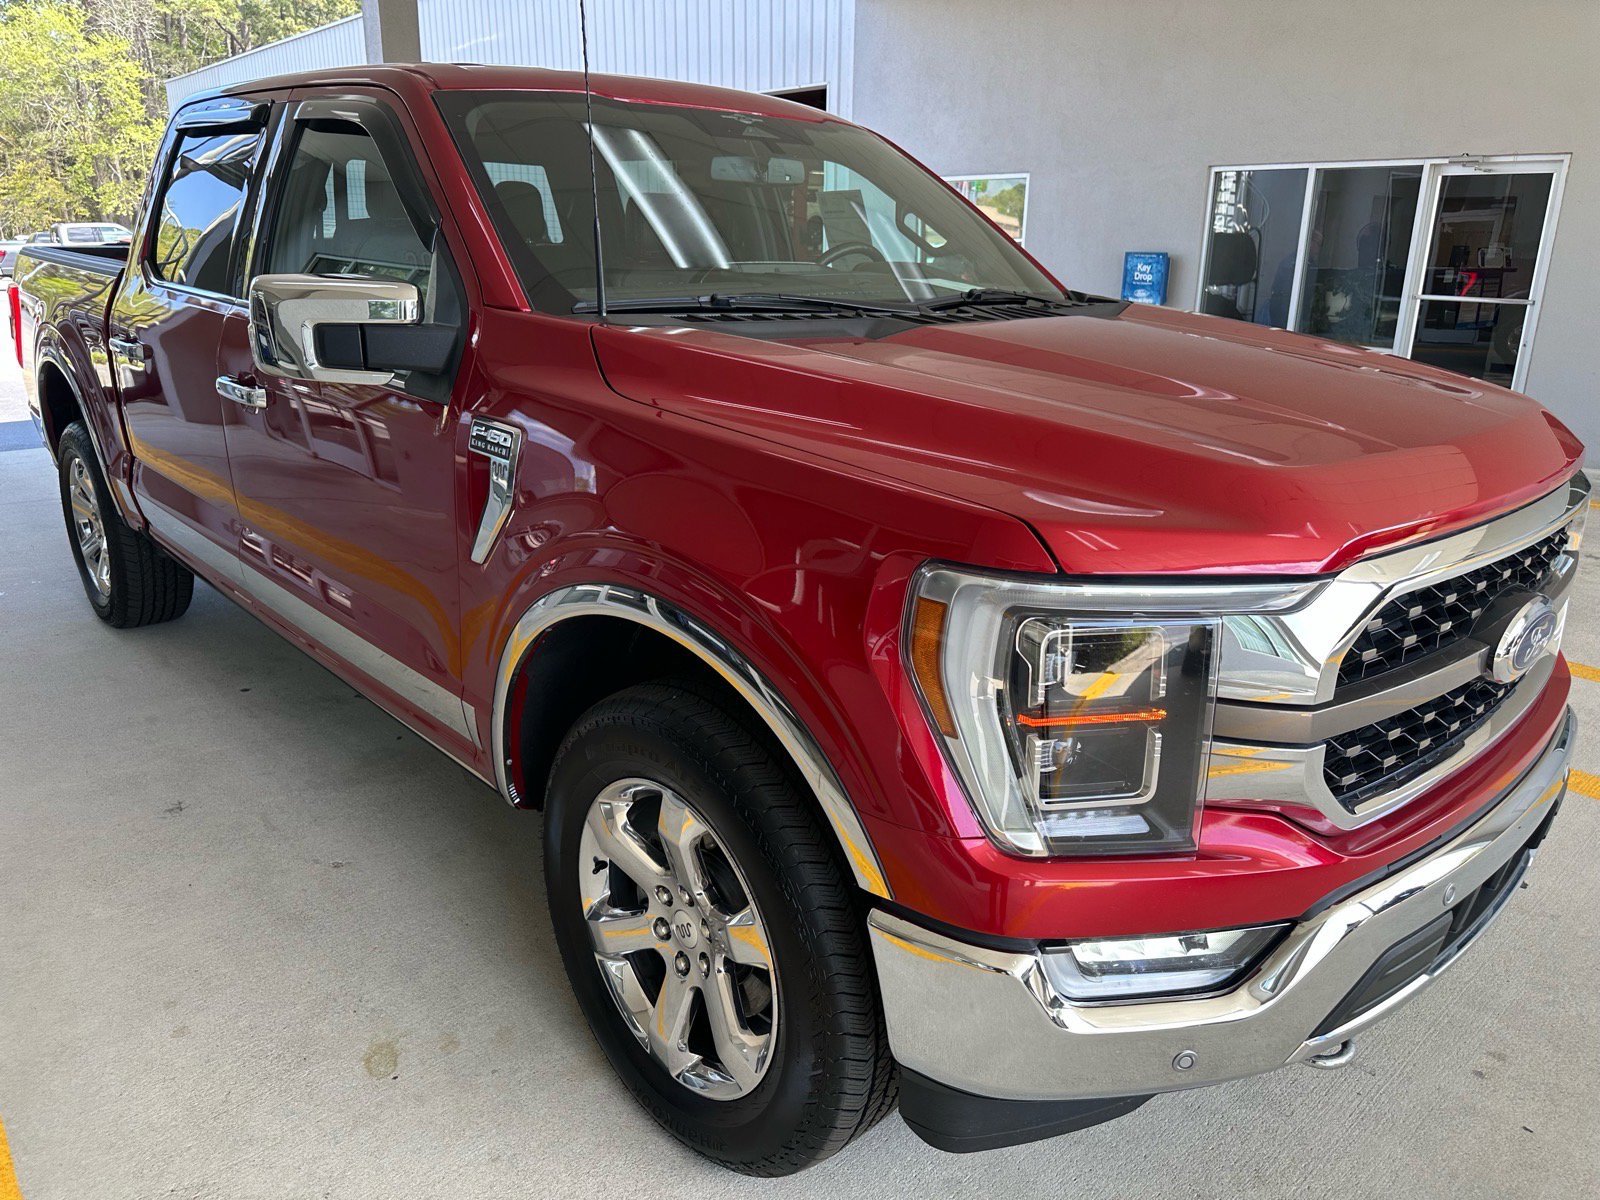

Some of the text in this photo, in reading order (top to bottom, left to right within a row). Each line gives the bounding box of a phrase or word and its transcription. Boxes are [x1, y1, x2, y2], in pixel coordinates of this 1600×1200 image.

[1137, 262, 1151, 273] Key
[1134, 272, 1153, 283] Drop
[471, 438, 507, 456] KING RANCH
